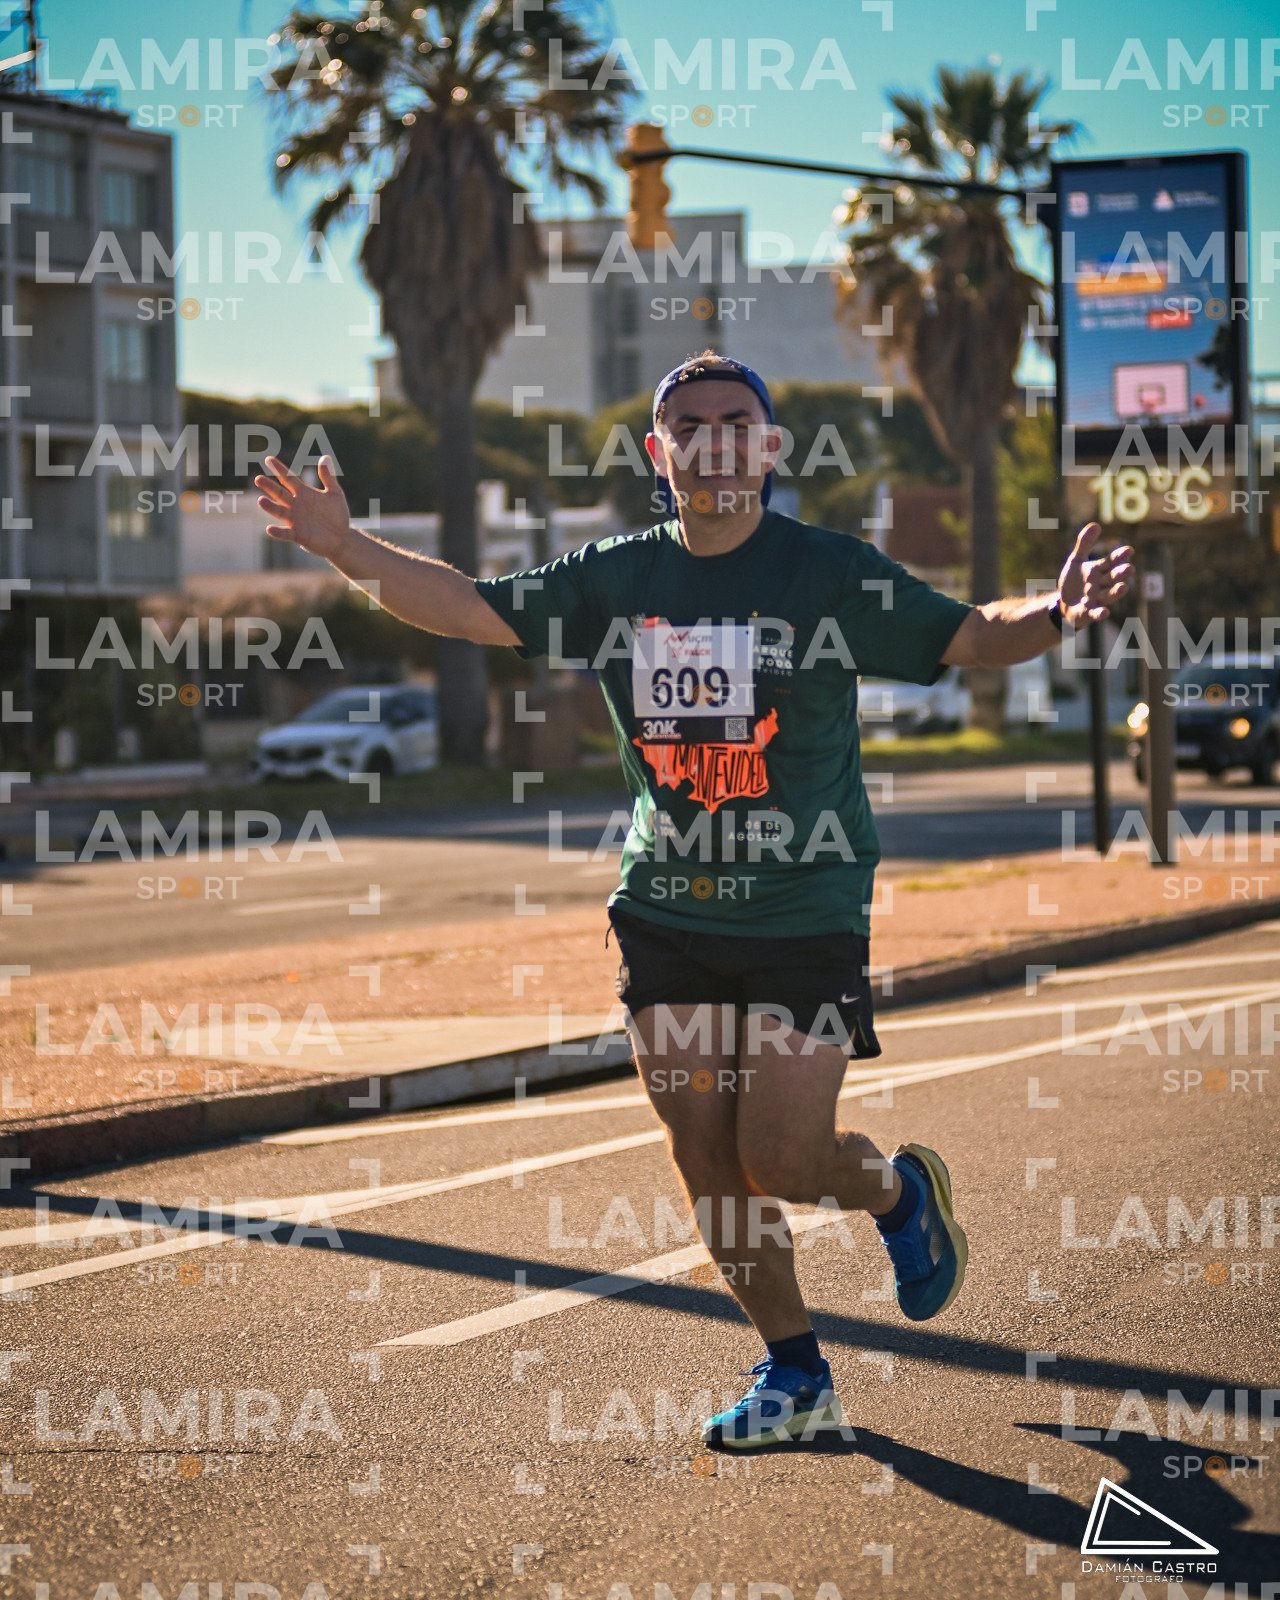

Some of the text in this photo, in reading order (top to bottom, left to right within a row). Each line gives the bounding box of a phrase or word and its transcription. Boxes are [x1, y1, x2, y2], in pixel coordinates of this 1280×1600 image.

[1088, 466, 1213, 523] 18°C
[753, 645, 794, 659] ARQUE
[652, 666, 730, 708] 609
[643, 720, 677, 739] 30K
[728, 831, 780, 841] AGOSTO
